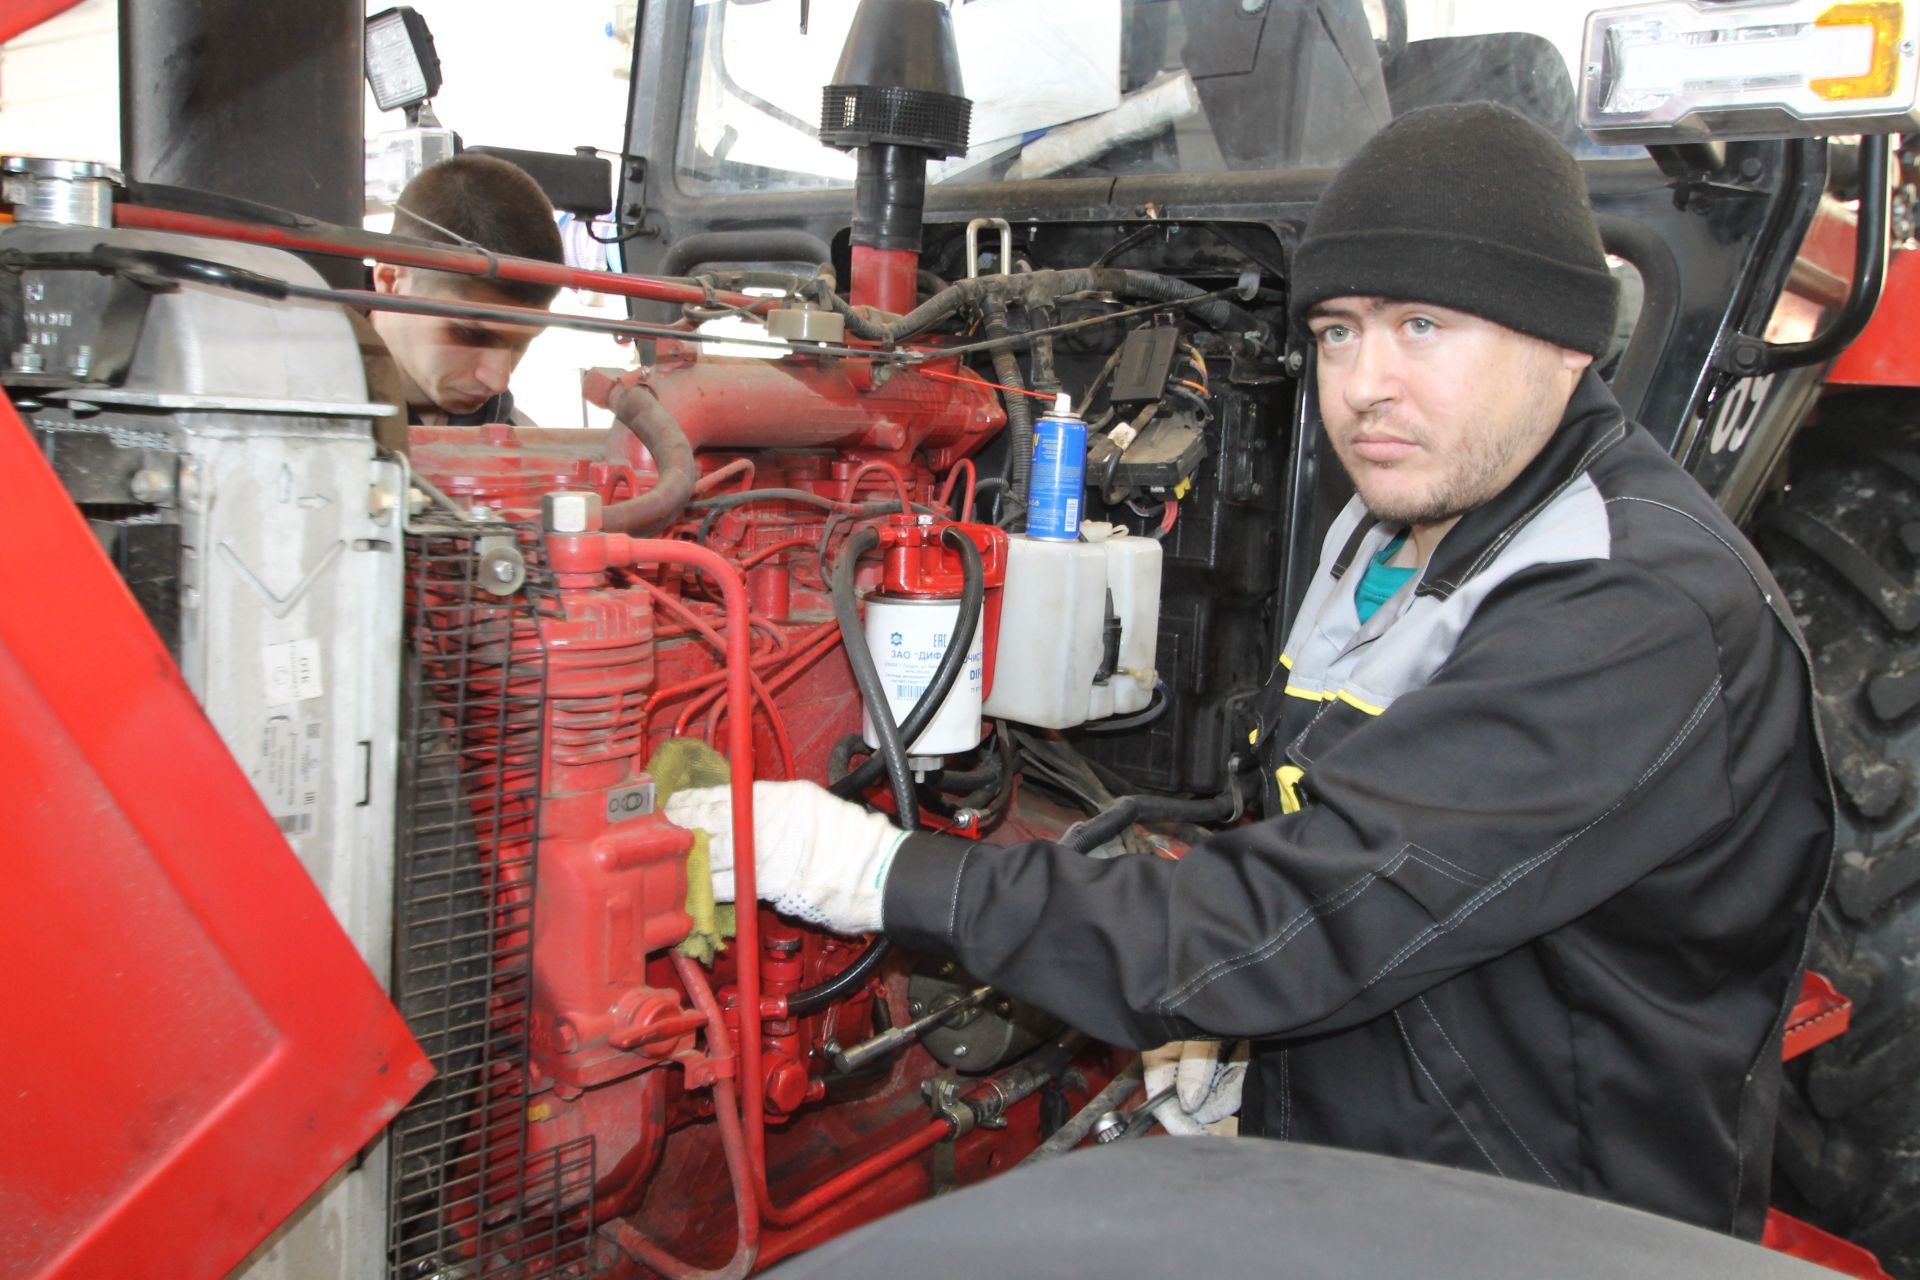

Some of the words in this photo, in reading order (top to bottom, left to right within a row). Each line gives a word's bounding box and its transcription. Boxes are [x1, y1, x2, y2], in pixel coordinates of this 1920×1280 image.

[890, 650, 911, 660] ЗАО
[913, 652, 942, 661] "ДИФ
[969, 668, 982, 680] DIF
